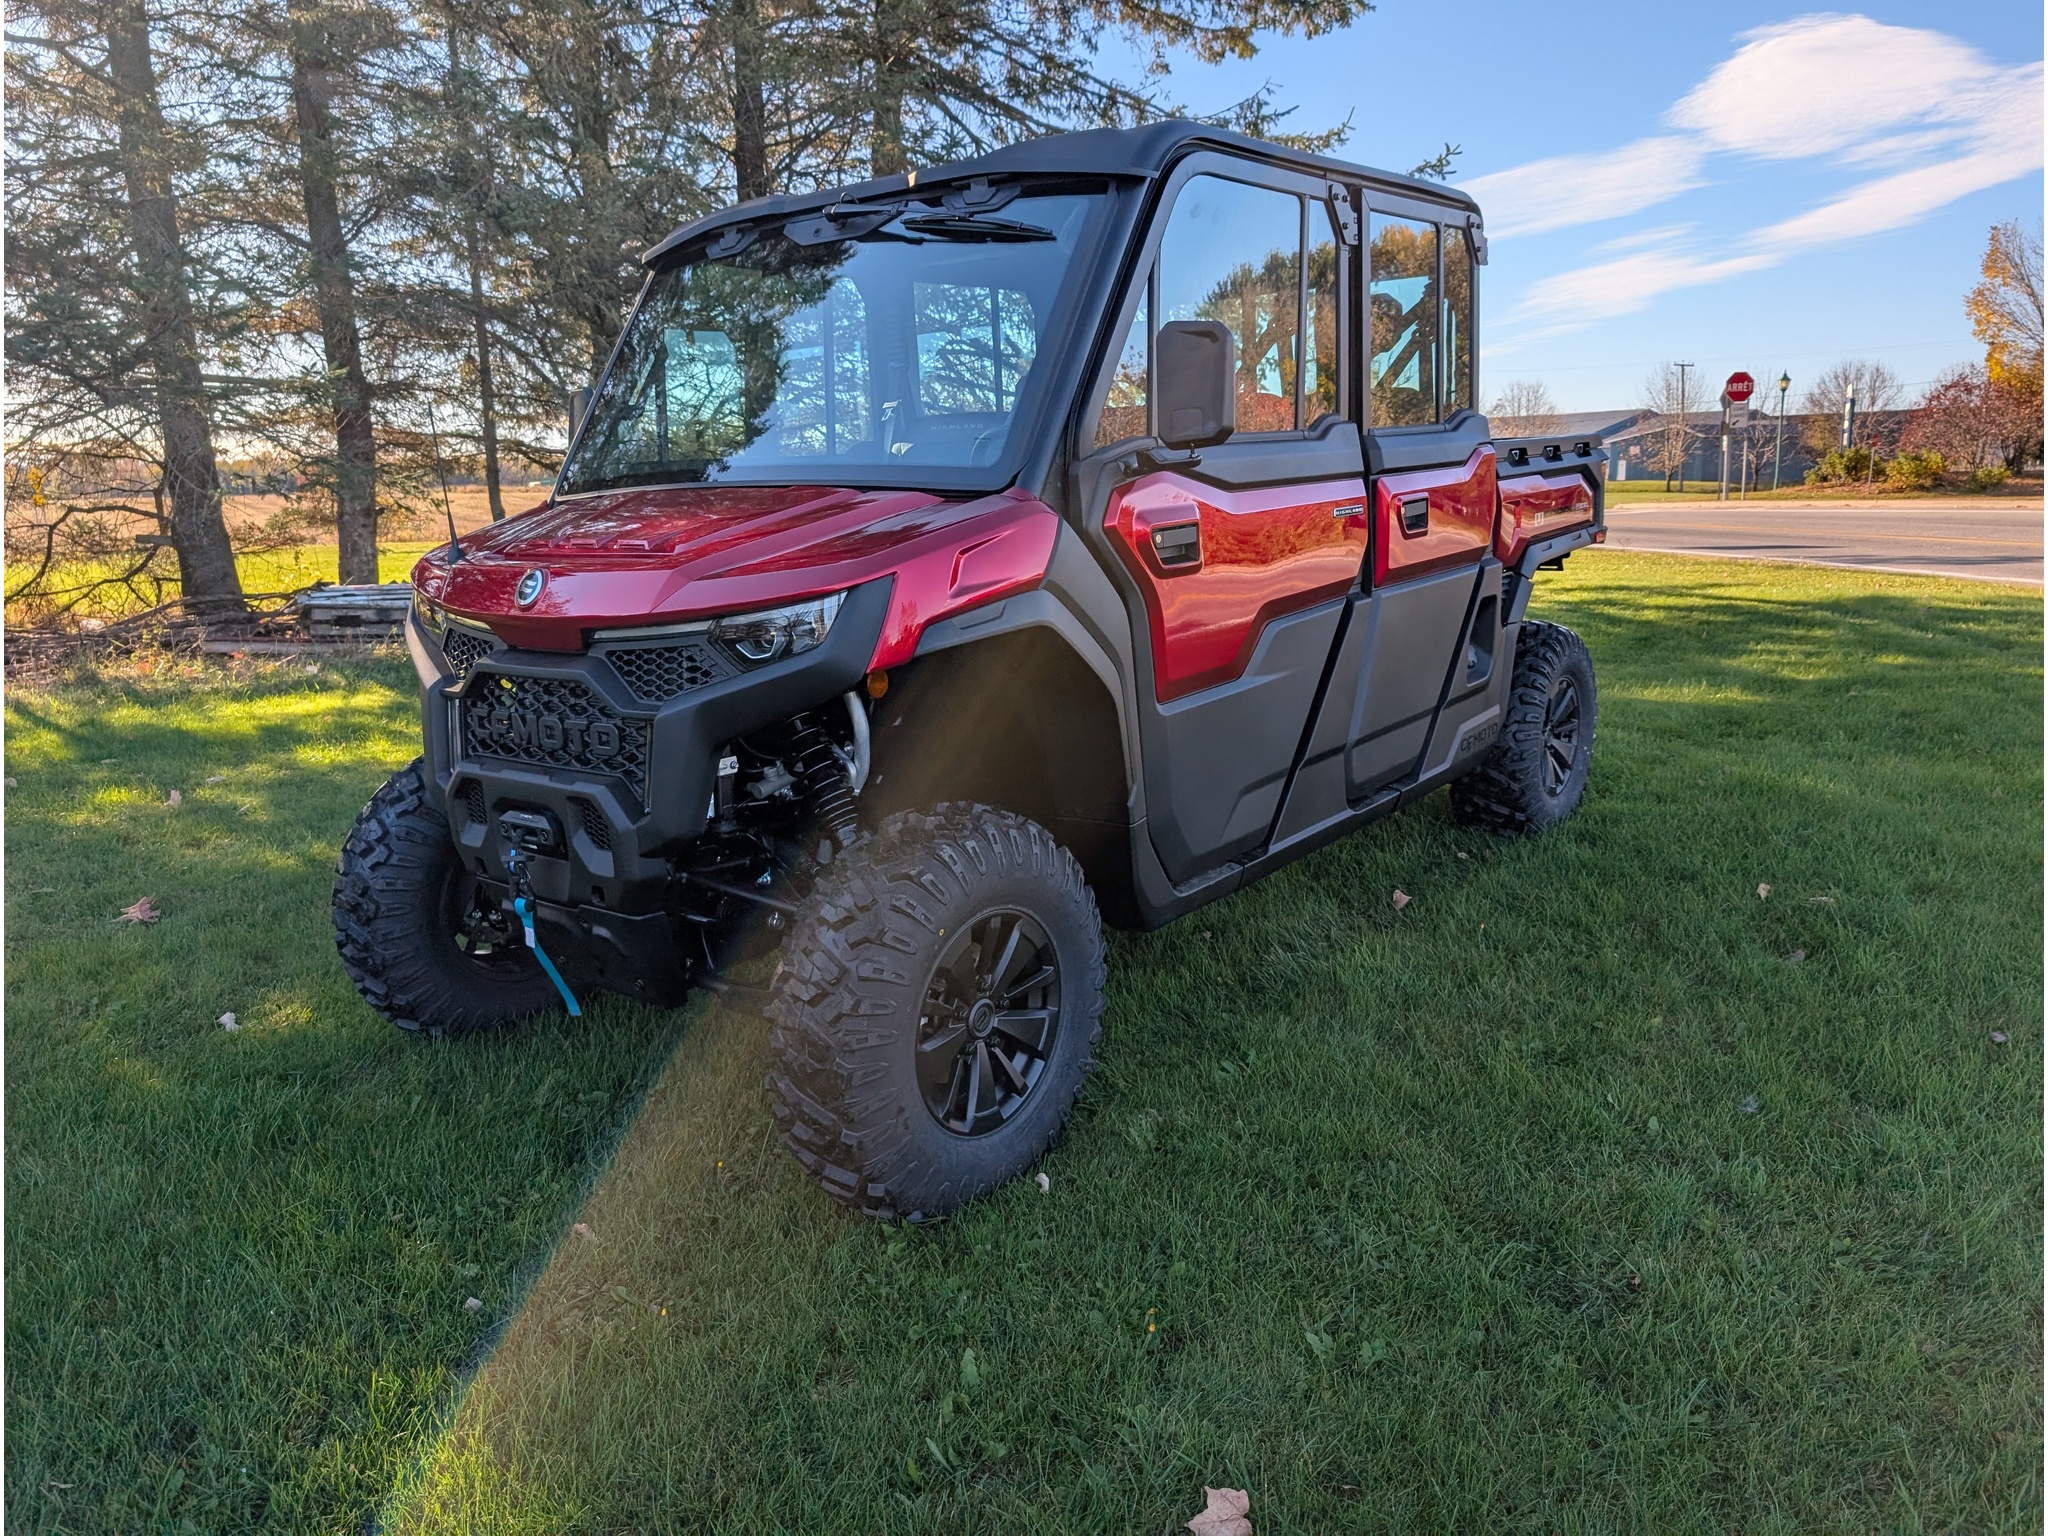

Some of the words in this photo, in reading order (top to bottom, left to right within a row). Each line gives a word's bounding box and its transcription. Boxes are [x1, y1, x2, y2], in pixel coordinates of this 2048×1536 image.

[1727, 380, 1753, 392] ARRÊT
[472, 707, 620, 756] CFMOTO
[1460, 722, 1498, 751] CFMOTO
